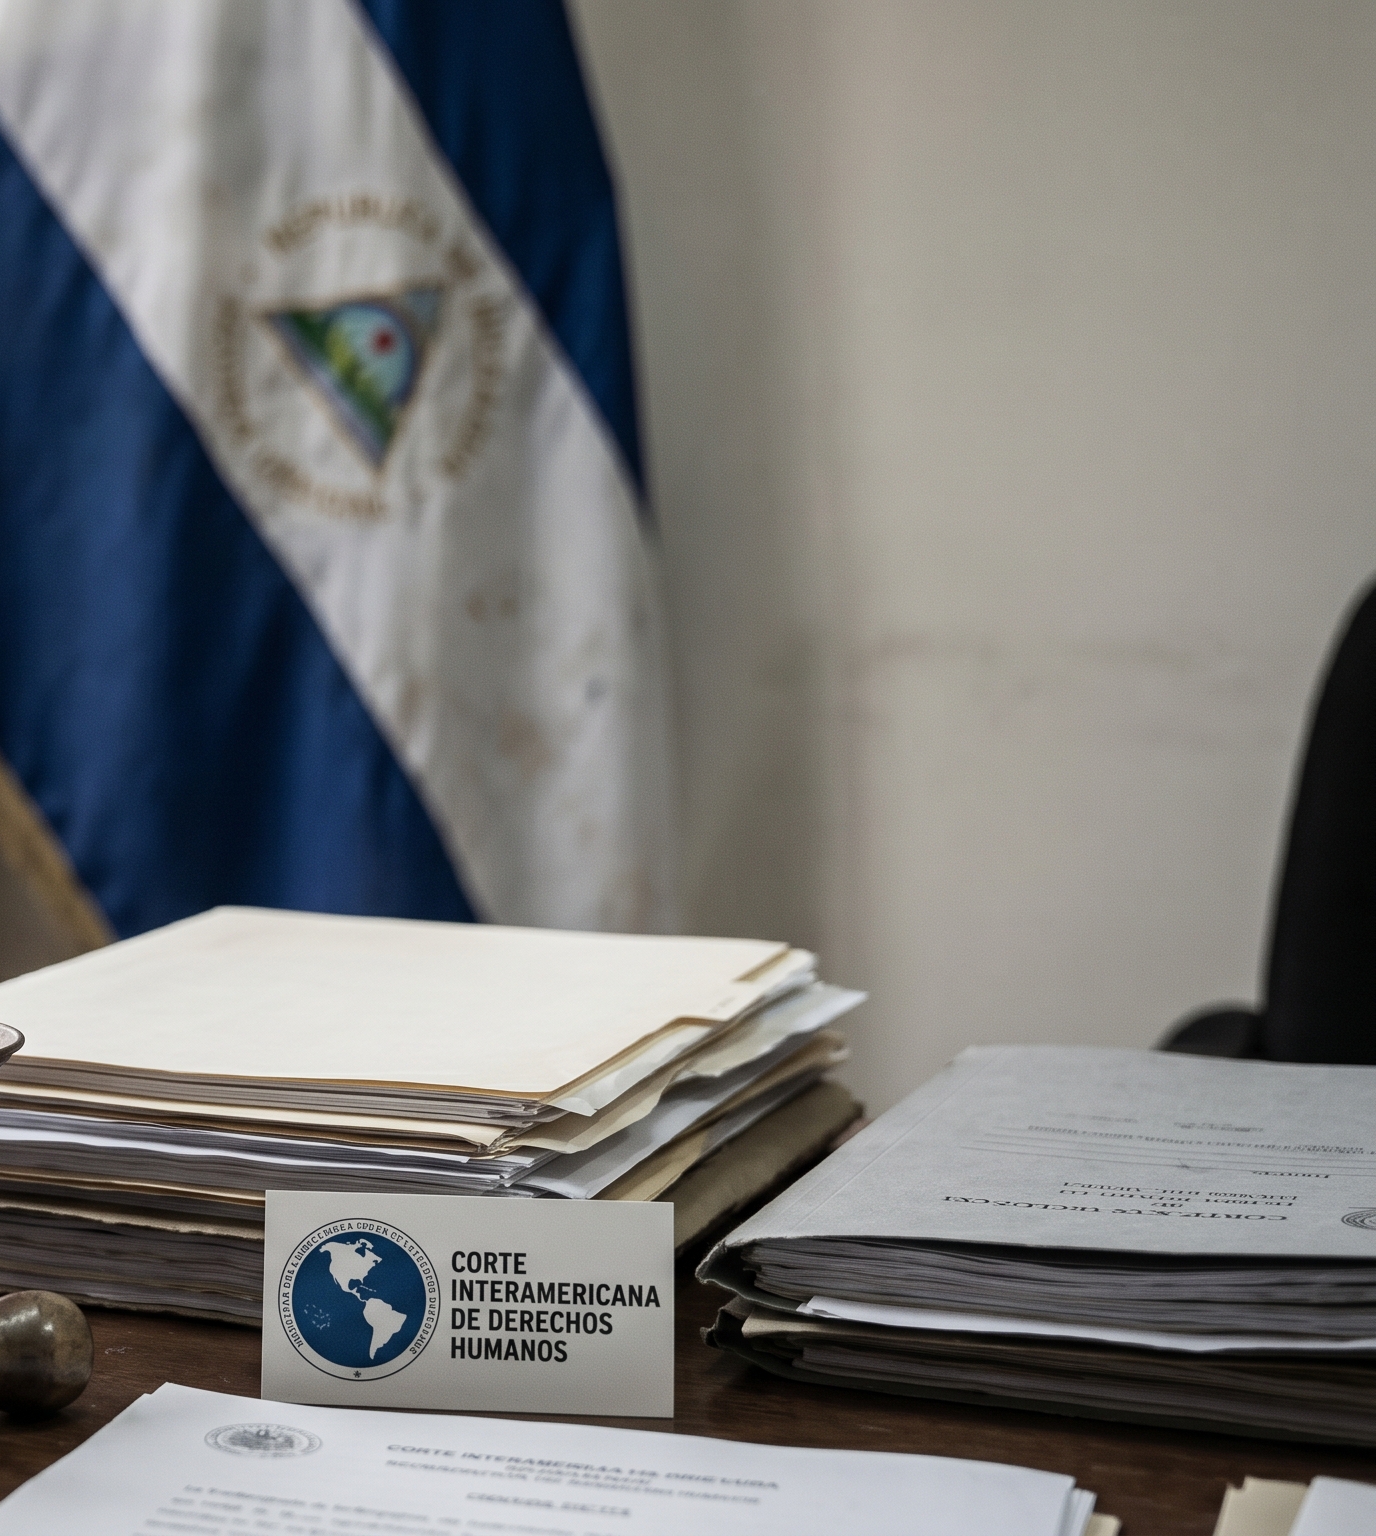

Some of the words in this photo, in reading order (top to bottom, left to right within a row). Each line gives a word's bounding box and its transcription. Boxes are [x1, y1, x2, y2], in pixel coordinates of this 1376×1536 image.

[452, 1251, 527, 1274] CORTE
[452, 1279, 660, 1307] INTERAMERICANA
[452, 1308, 480, 1330] DE
[489, 1309, 613, 1335] DERECHOS
[451, 1337, 568, 1362] HUMANOS
